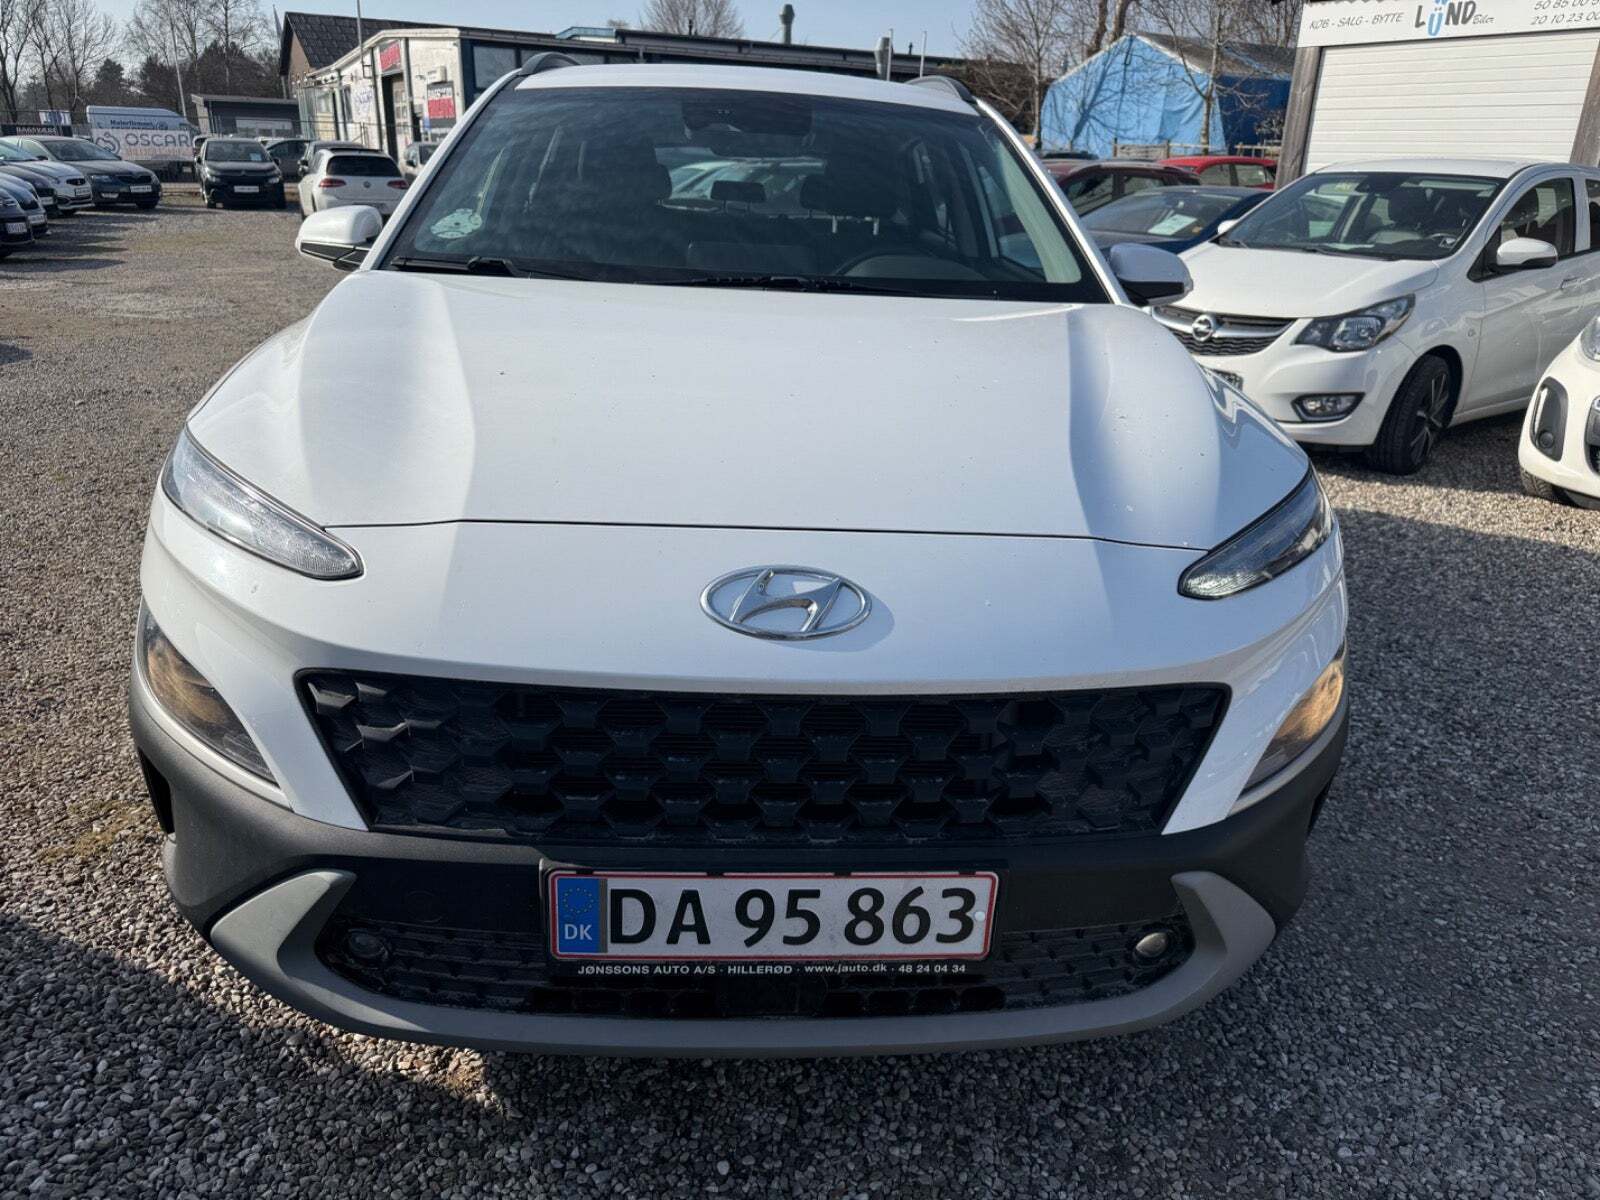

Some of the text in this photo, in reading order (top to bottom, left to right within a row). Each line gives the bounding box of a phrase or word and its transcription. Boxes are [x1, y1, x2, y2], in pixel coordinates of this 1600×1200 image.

[1337, 15, 1364, 28] SALG
[1371, 12, 1405, 25] BYTTE
[125, 133, 192, 147] OSCAR
[610, 886, 976, 948] DA 95 863
[564, 923, 593, 941] DK
[577, 963, 967, 975] JØNSSONS AUTO A/S HILLERØD www.jauto.dk 48 24 04 34
